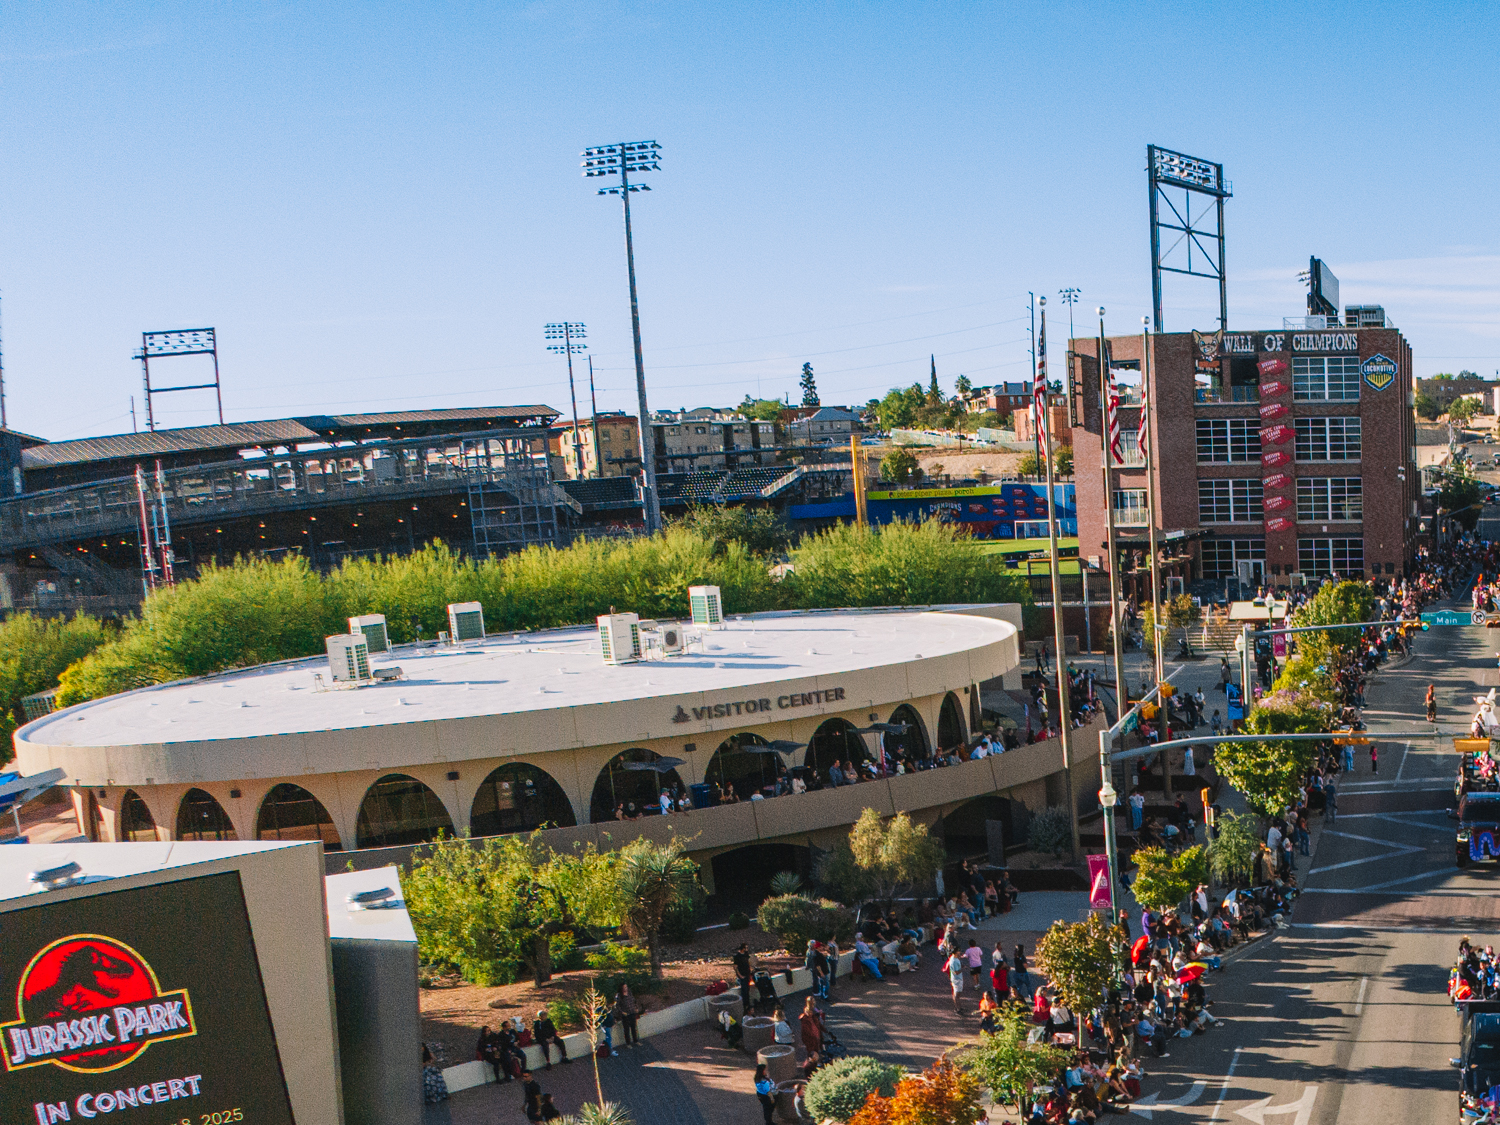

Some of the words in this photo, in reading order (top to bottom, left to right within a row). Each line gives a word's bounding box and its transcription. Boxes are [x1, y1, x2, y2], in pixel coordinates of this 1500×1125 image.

[1223, 334, 1254, 352] WALL
[1264, 334, 1285, 351] OF
[1292, 333, 1358, 351] CHAMPIONS
[954, 488, 974, 496] porch
[1436, 616, 1458, 624] Main
[692, 698, 771, 720] VISITOR
[778, 687, 846, 709] CENTER
[9, 1013, 116, 1064] JURASSIC
[113, 1000, 189, 1043] PARK
